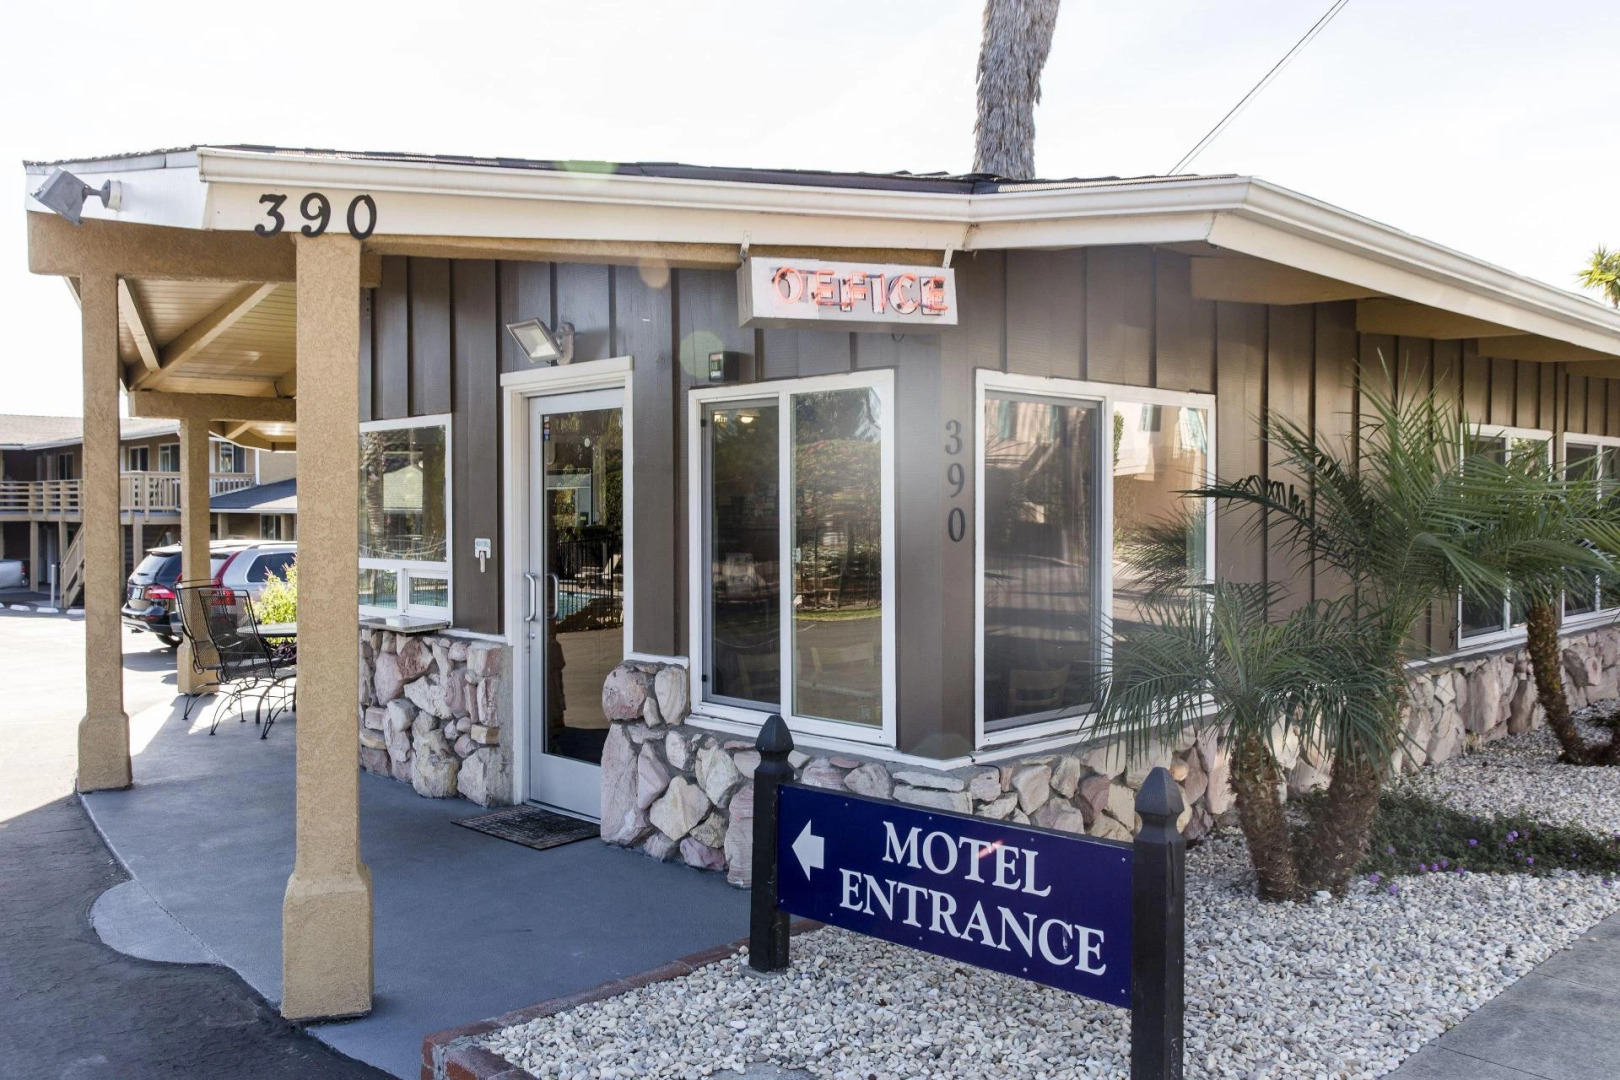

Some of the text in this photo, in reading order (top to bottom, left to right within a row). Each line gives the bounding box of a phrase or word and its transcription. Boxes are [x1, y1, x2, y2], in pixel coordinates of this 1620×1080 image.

[254, 192, 377, 240] 390
[773, 266, 949, 314] OFFICE
[945, 419, 966, 542] 390
[882, 821, 1052, 897] MOTEL
[839, 868, 1107, 976] ENTRANCE
